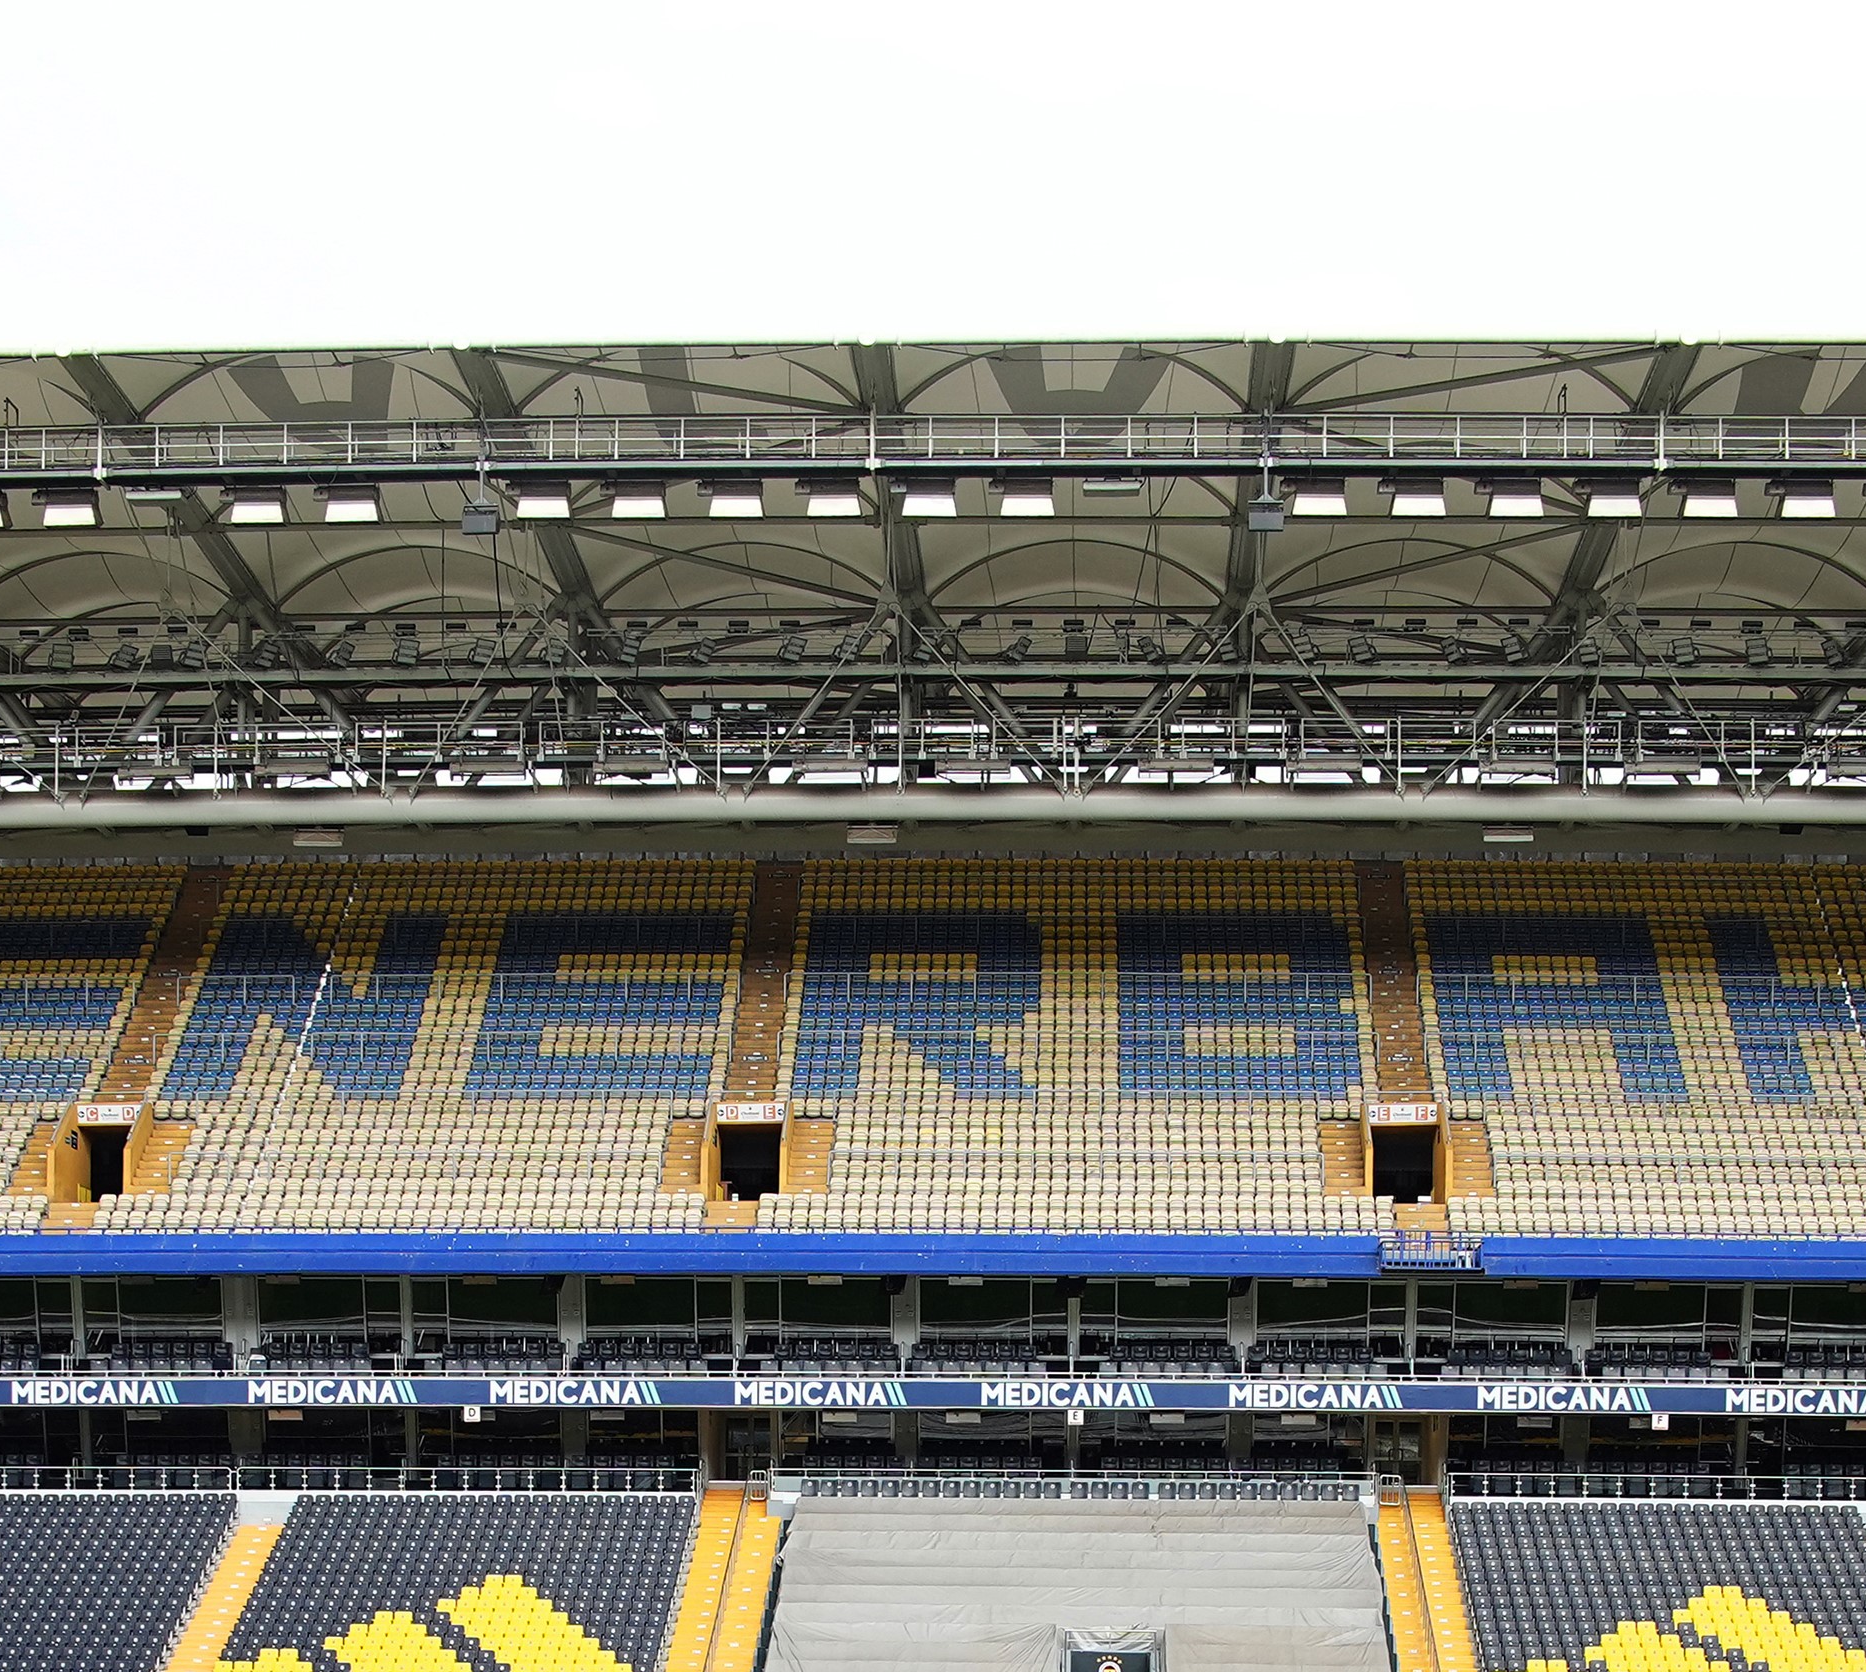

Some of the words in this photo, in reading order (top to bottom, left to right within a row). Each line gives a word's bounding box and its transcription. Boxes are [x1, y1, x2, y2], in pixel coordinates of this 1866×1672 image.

[11, 1381, 160, 1404] MEDICANA
[248, 1380, 397, 1404] MEDICANA
[489, 1381, 638, 1404] MEDICANA
[734, 1382, 887, 1405] MEDICANA
[980, 1383, 1134, 1407] MEDICANA
[1228, 1384, 1384, 1408] MEDICANA
[1477, 1387, 1632, 1411] MEDICANA
